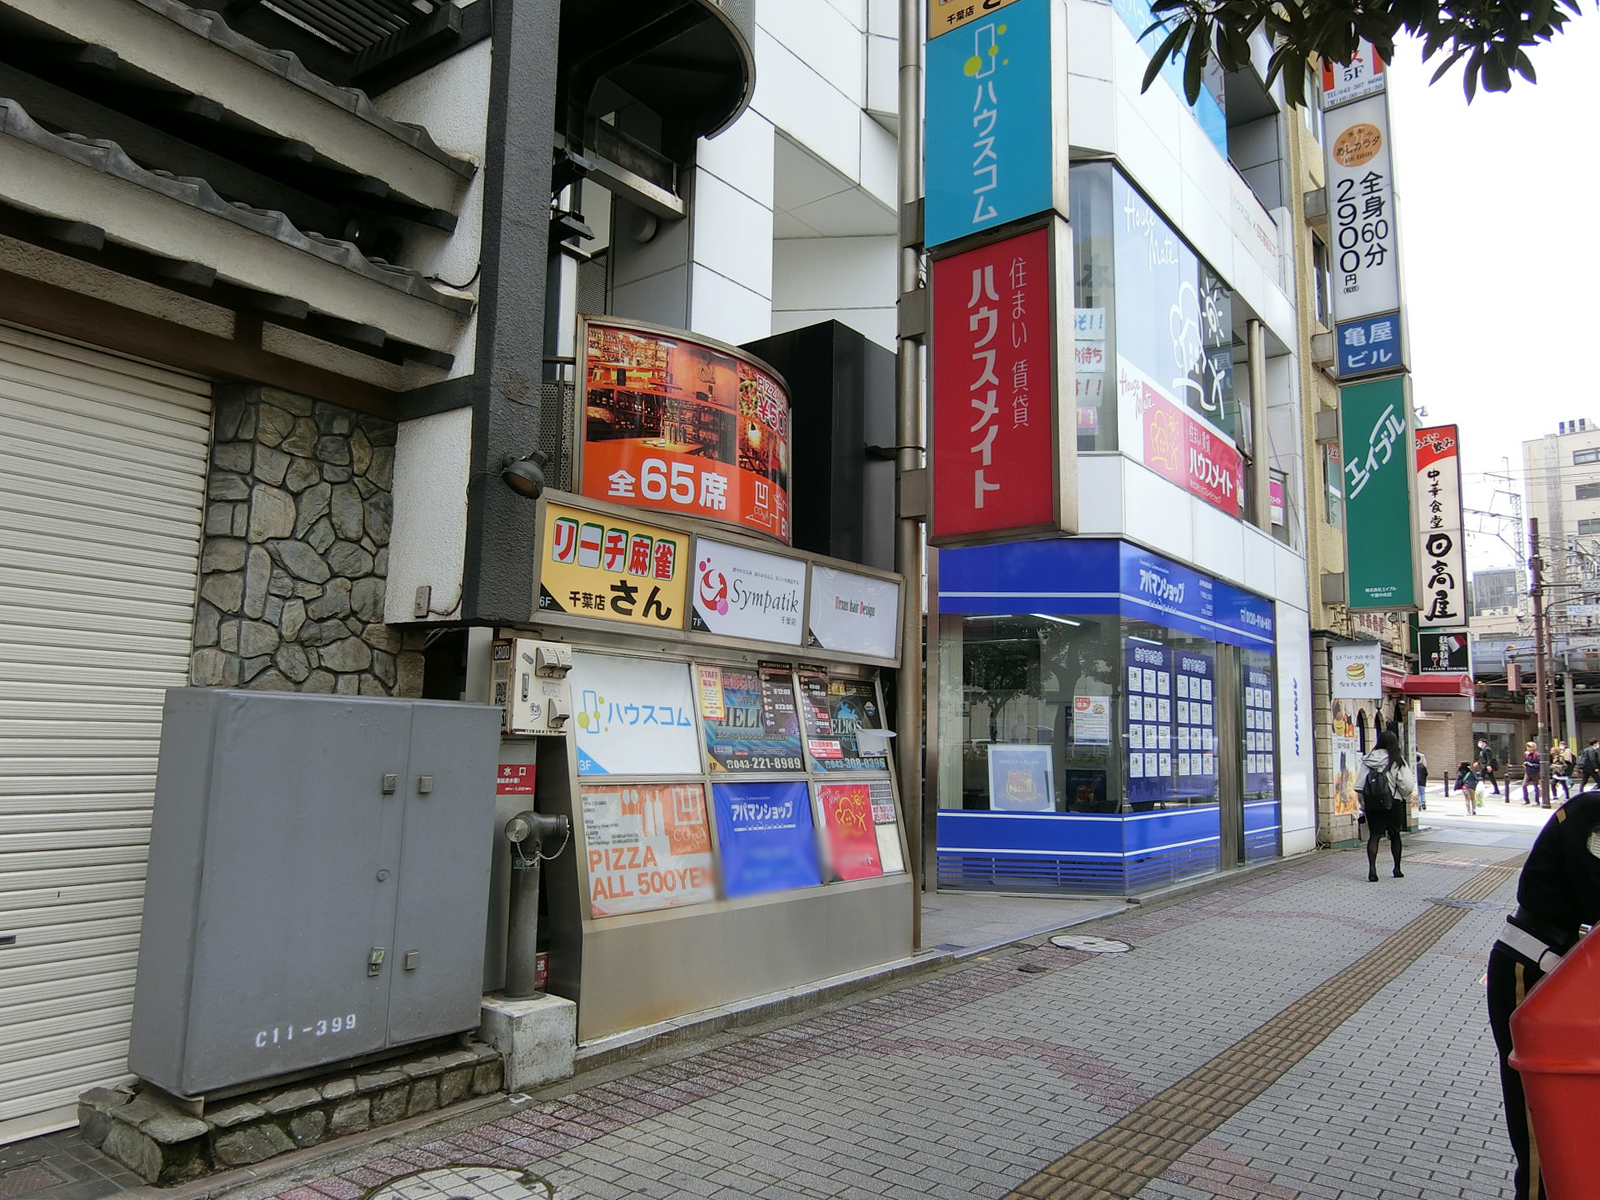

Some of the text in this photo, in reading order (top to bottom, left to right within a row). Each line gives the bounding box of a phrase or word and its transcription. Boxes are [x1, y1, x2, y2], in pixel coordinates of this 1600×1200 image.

[946, 5, 975, 25] 千葉店
[1343, 64, 1365, 82] 5F
[972, 80, 999, 224] ハウスコム
[1359, 171, 1389, 269] 全身60分
[1009, 256, 1030, 429] 住まい 賃貸
[1344, 321, 1393, 348] 亀屋
[1347, 347, 1393, 368] ビル
[967, 264, 1001, 510] ハウスメイト
[1344, 403, 1406, 500] エイブル
[607, 458, 728, 509] 全65席
[1189, 446, 1233, 498] ハウスメイト
[1426, 467, 1443, 529] 中華食堂
[554, 523, 674, 580] リーチ麻雀
[1139, 568, 1185, 604] アパマンショップ
[1421, 532, 1458, 622] 日高屋
[539, 595, 552, 607] 6F
[568, 579, 673, 621] 千葉店 さん
[730, 578, 799, 614] Sympatik
[693, 617, 702, 627] 7F
[780, 616, 797, 627] 千葉店
[700, 670, 718, 679] STAFF
[608, 702, 692, 727] ハウスコム
[579, 760, 591, 771] 3F
[733, 757, 801, 769] 043-221-8989
[731, 800, 793, 821] アパマンショップ
[588, 846, 657, 873] PIZZA
[592, 874, 634, 901] ALL
[255, 1013, 356, 1048] C11-399
